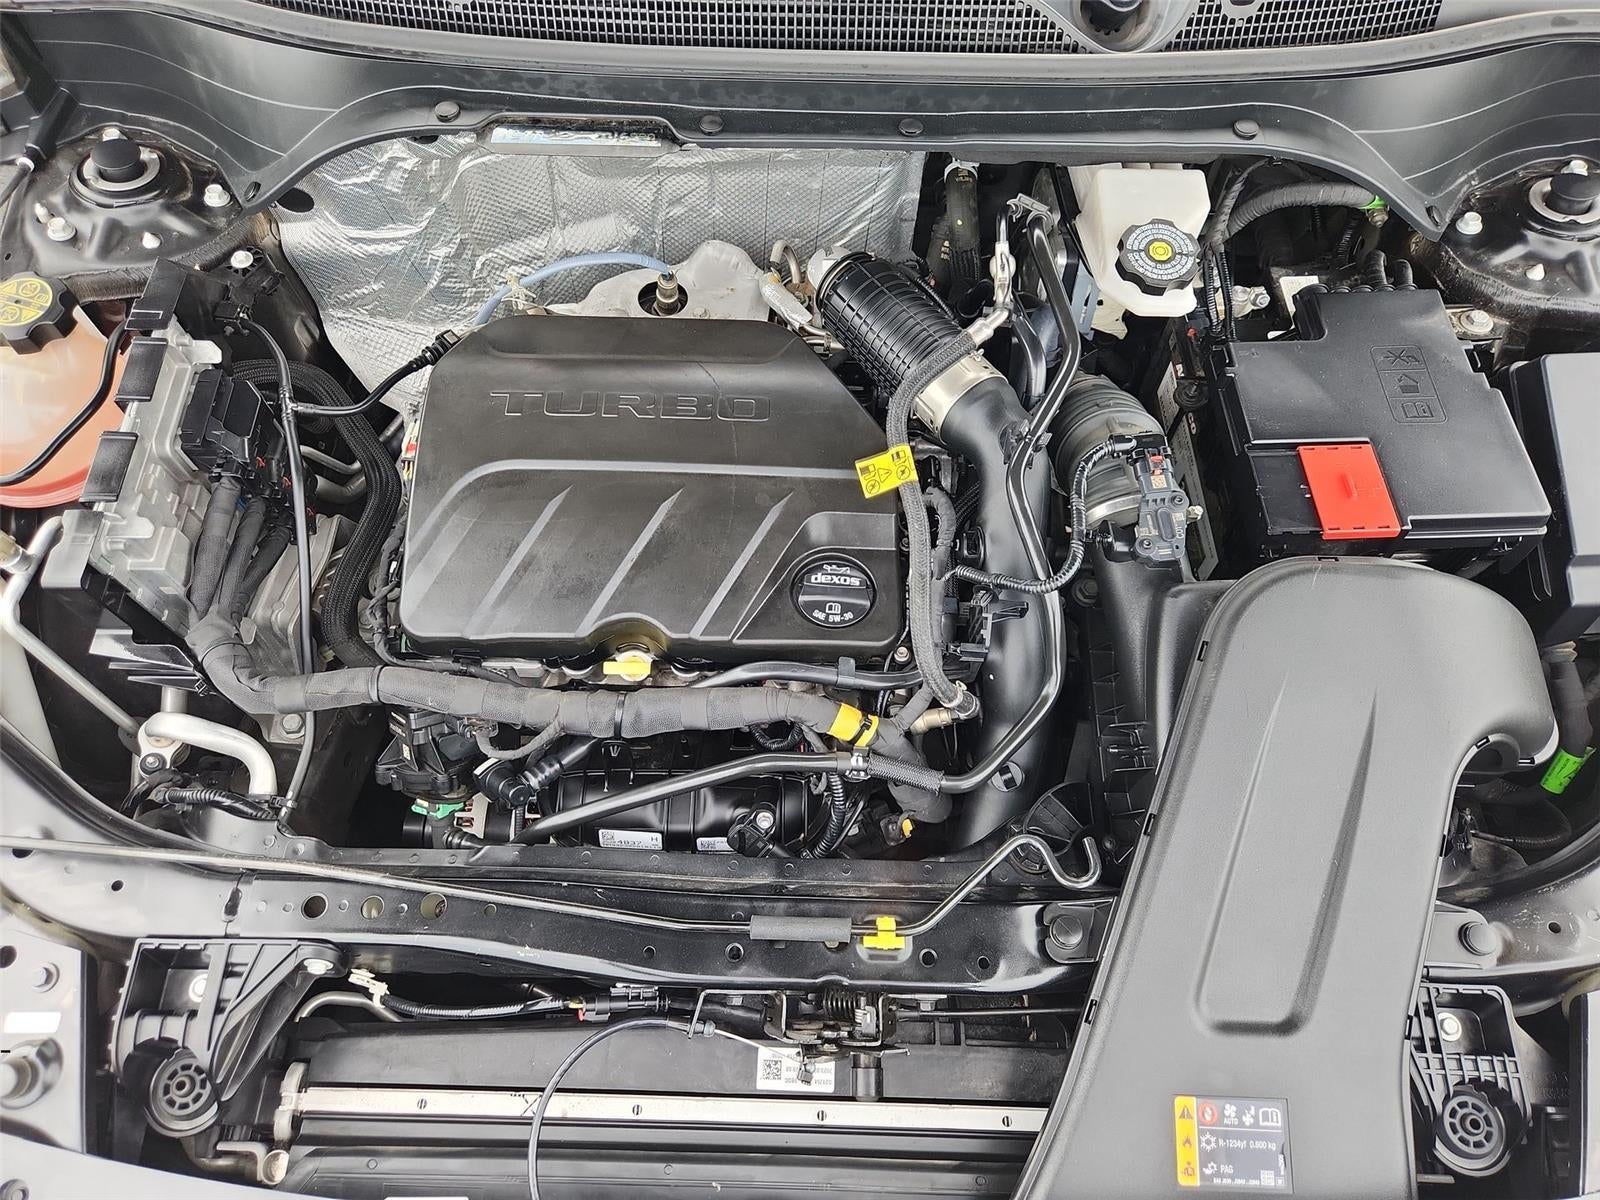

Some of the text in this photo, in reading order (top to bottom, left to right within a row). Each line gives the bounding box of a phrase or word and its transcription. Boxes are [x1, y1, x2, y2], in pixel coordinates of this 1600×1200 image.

[489, 391, 771, 422] TURBO
[810, 572, 861, 586] dexos
[812, 609, 854, 622] SAE 5W-30
[1268, 1141, 1276, 1151] kg
[1220, 1164, 1234, 1174] PAG
